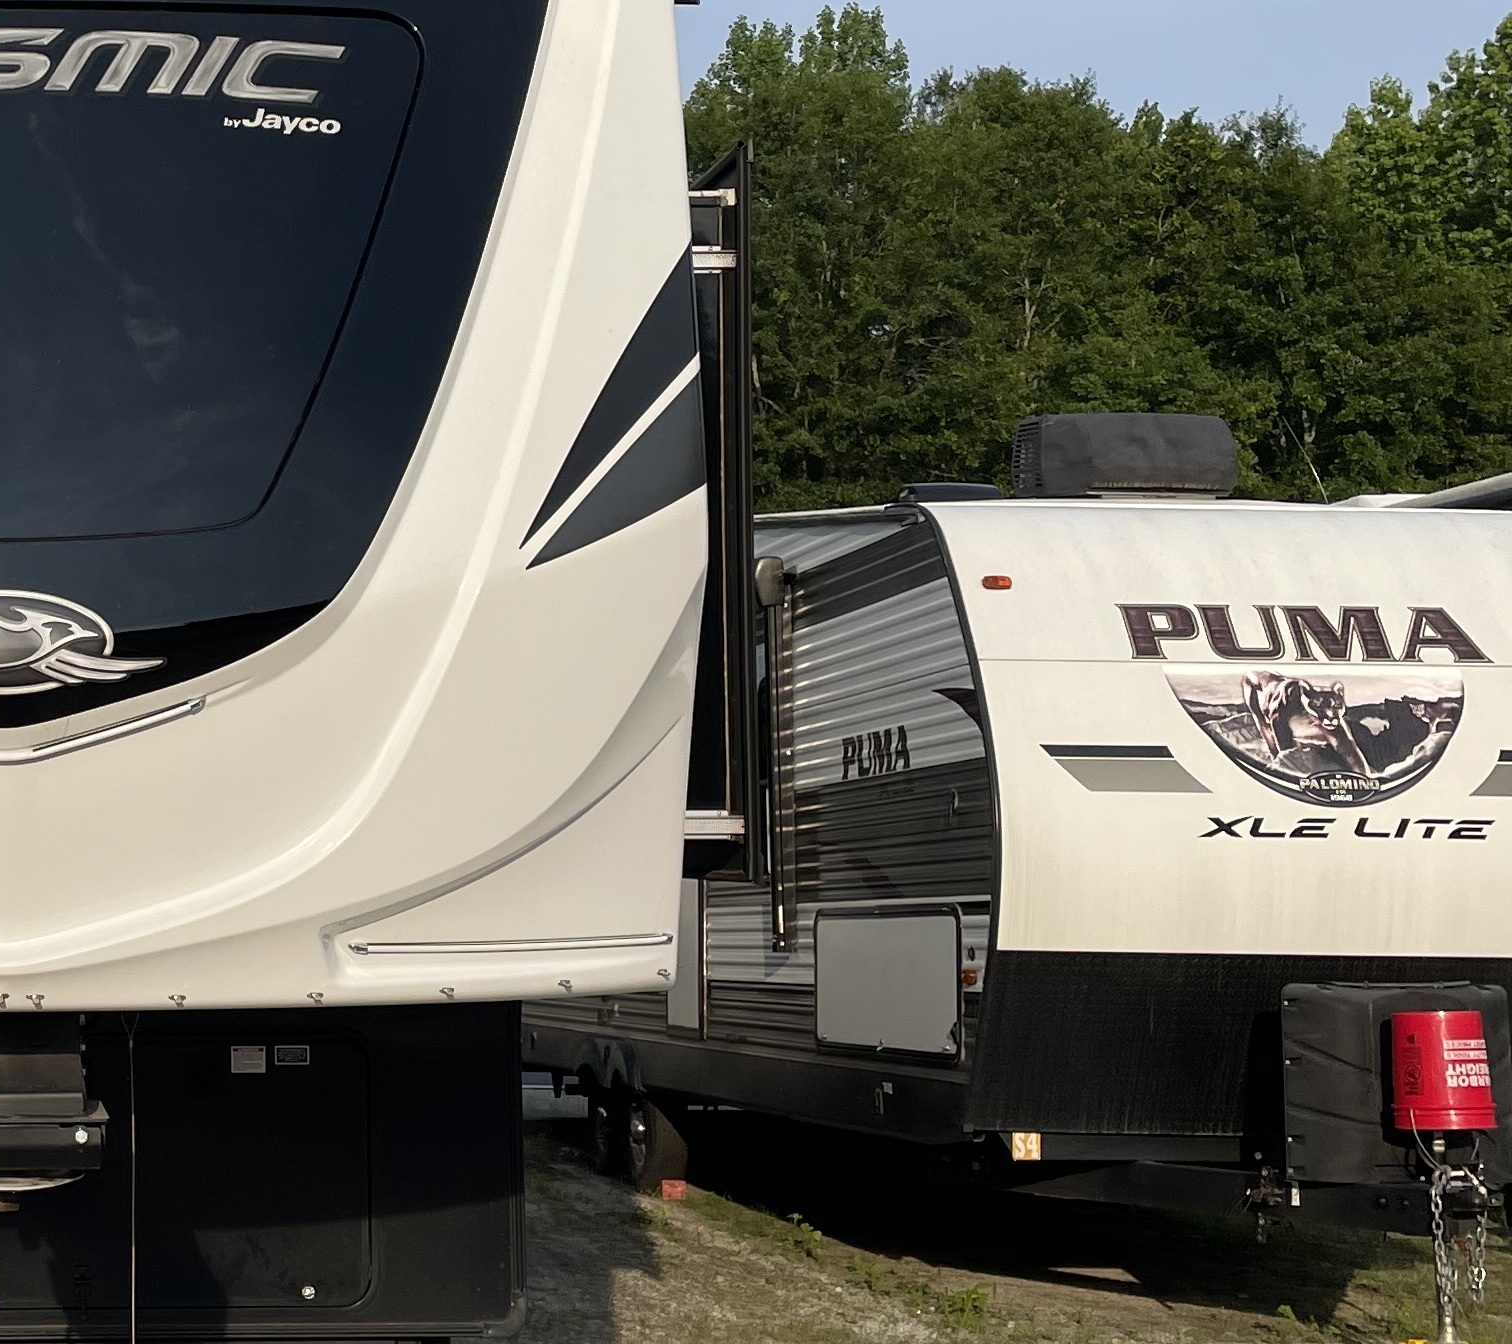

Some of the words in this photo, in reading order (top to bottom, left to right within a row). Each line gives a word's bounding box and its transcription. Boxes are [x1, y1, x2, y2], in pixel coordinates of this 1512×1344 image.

[223, 116, 241, 128] by
[242, 107, 341, 135] Jayco
[1114, 603, 1495, 663] PUMA
[841, 725, 910, 780] PUMA
[1299, 778, 1380, 791] PALOMINO
[1197, 815, 1337, 838] XLE
[1353, 817, 1495, 840] LITE
